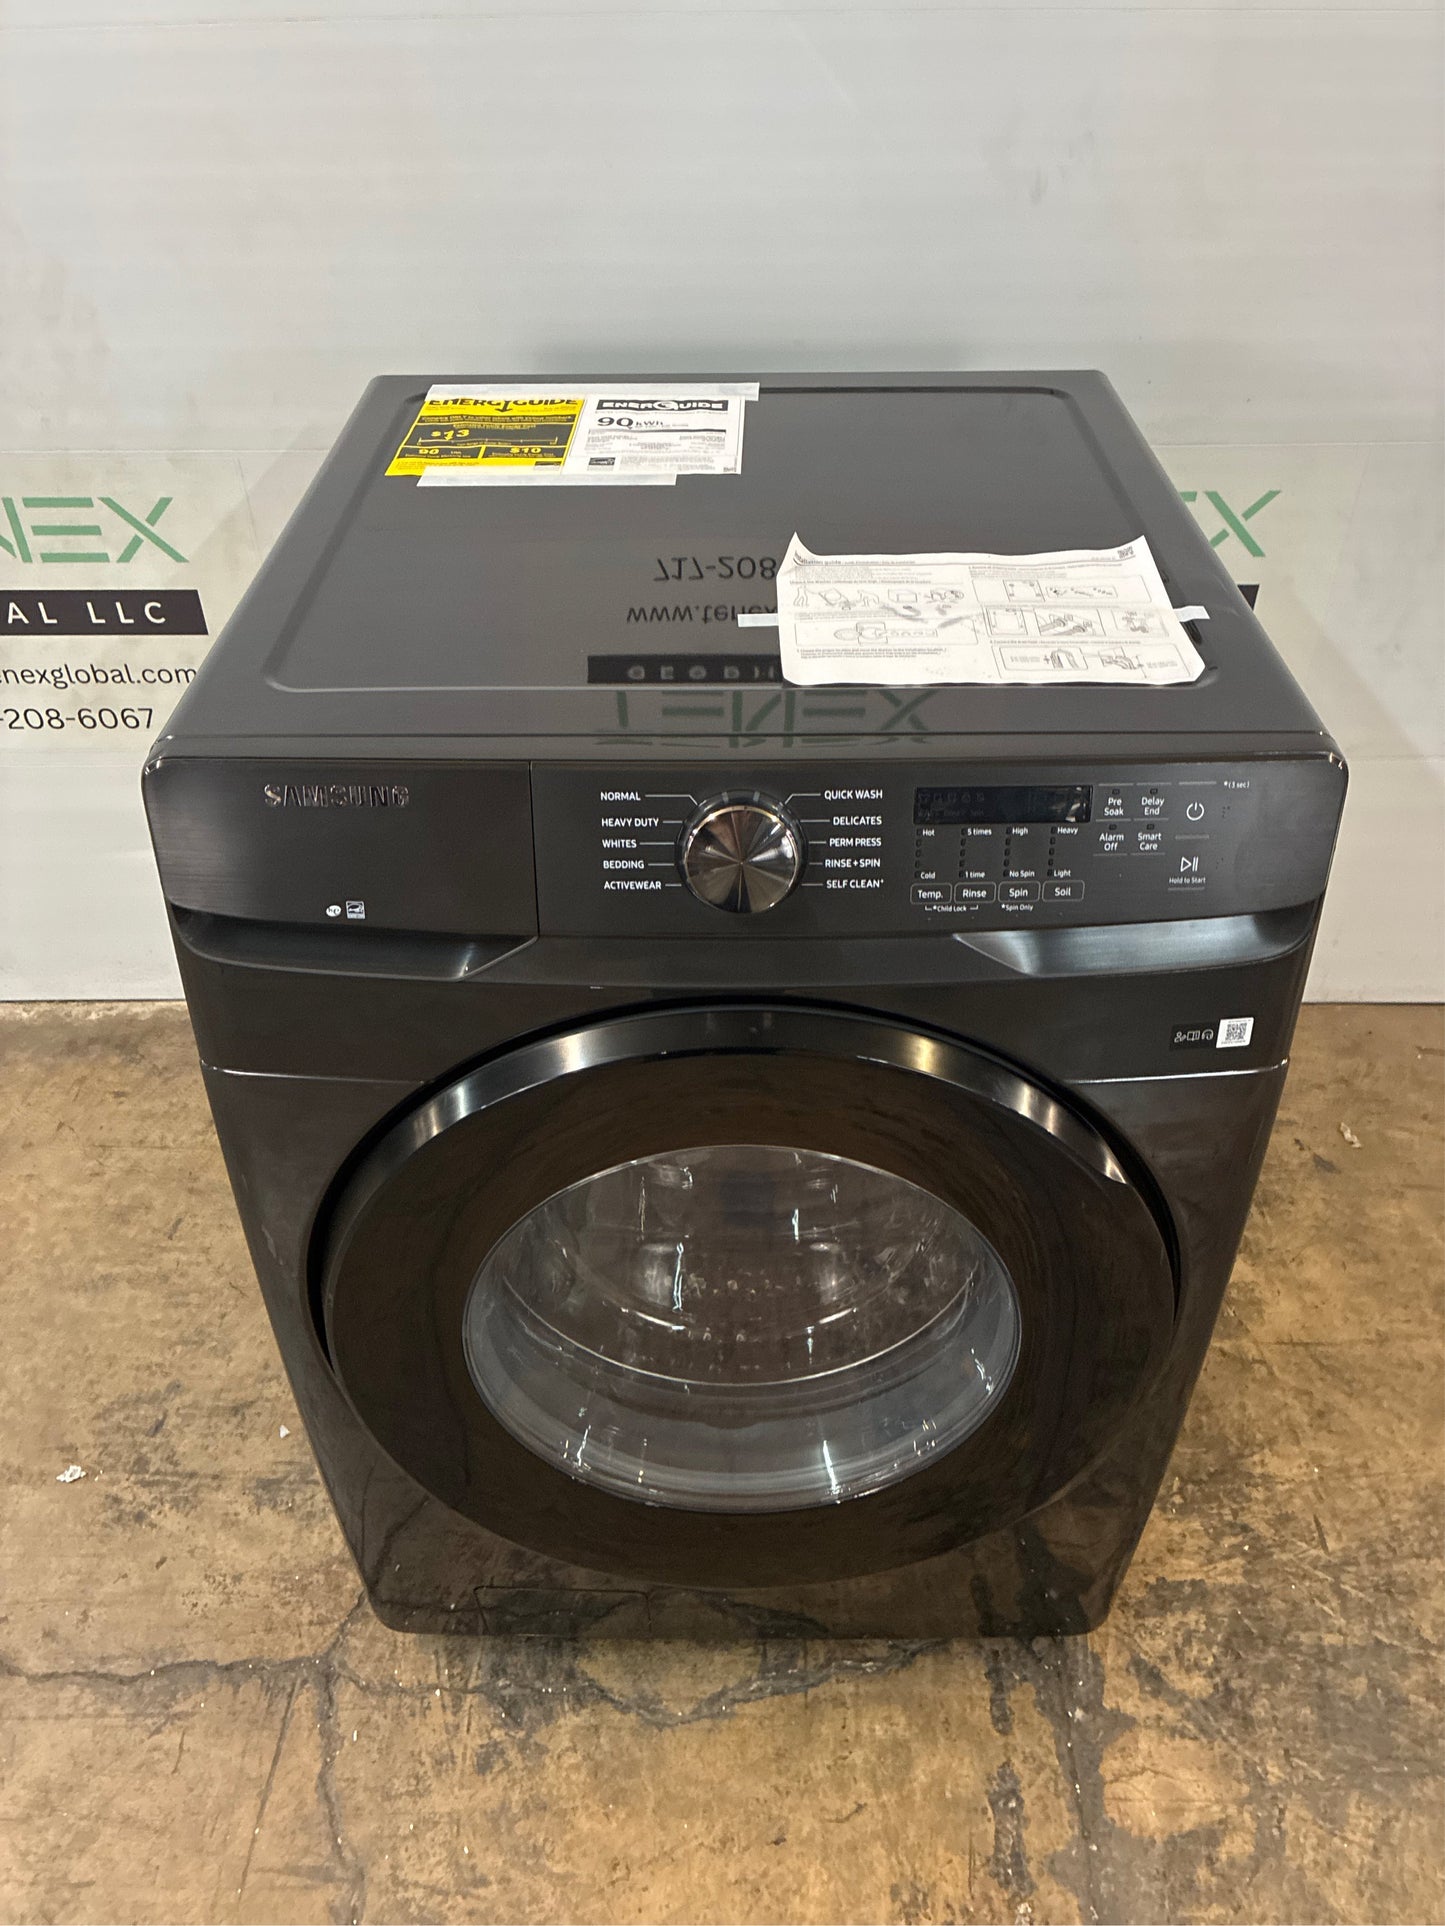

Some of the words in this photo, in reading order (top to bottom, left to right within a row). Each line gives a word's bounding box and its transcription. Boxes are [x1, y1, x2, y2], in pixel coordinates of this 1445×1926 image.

[86, 602, 166, 624] LLC
[264, 784, 410, 808] SAMSUNG
[600, 792, 641, 801] NORMAL
[824, 790, 853, 800] QUICK
[855, 790, 883, 799] WASH
[1108, 797, 1122, 806] Pre
[1141, 796, 1165, 807] Delay
[1104, 807, 1124, 816] Soak
[1144, 806, 1160, 816] End
[601, 818, 632, 827] HEAVY
[634, 817, 659, 827] DUTY
[833, 816, 882, 825] DELICATES
[973, 828, 992, 836] times
[1012, 827, 1029, 835] High
[1057, 827, 1079, 835] Heavy
[1099, 832, 1125, 841] Alarm
[1137, 832, 1162, 841] Smart
[602, 839, 637, 848] WHITES
[830, 838, 854, 847] PERM
[856, 838, 882, 846] PRESS
[1104, 842, 1118, 851] Off
[1139, 842, 1158, 851] Care
[603, 860, 645, 869] BEDDING
[1021, 870, 1035, 878] Spin
[1054, 869, 1071, 878] Light
[826, 879, 848, 889] SELF
[1168, 876, 1182, 884] Hold
[1191, 876, 1206, 884] Start
[604, 881, 662, 890] ACTIVEWEAR
[918, 889, 943, 900] Temp.
[962, 889, 987, 898] Rinse
[1009, 888, 1028, 898] Spin
[1054, 887, 1071, 896] Soil
[953, 904, 967, 912] Lock
[1019, 903, 1033, 912] Only
